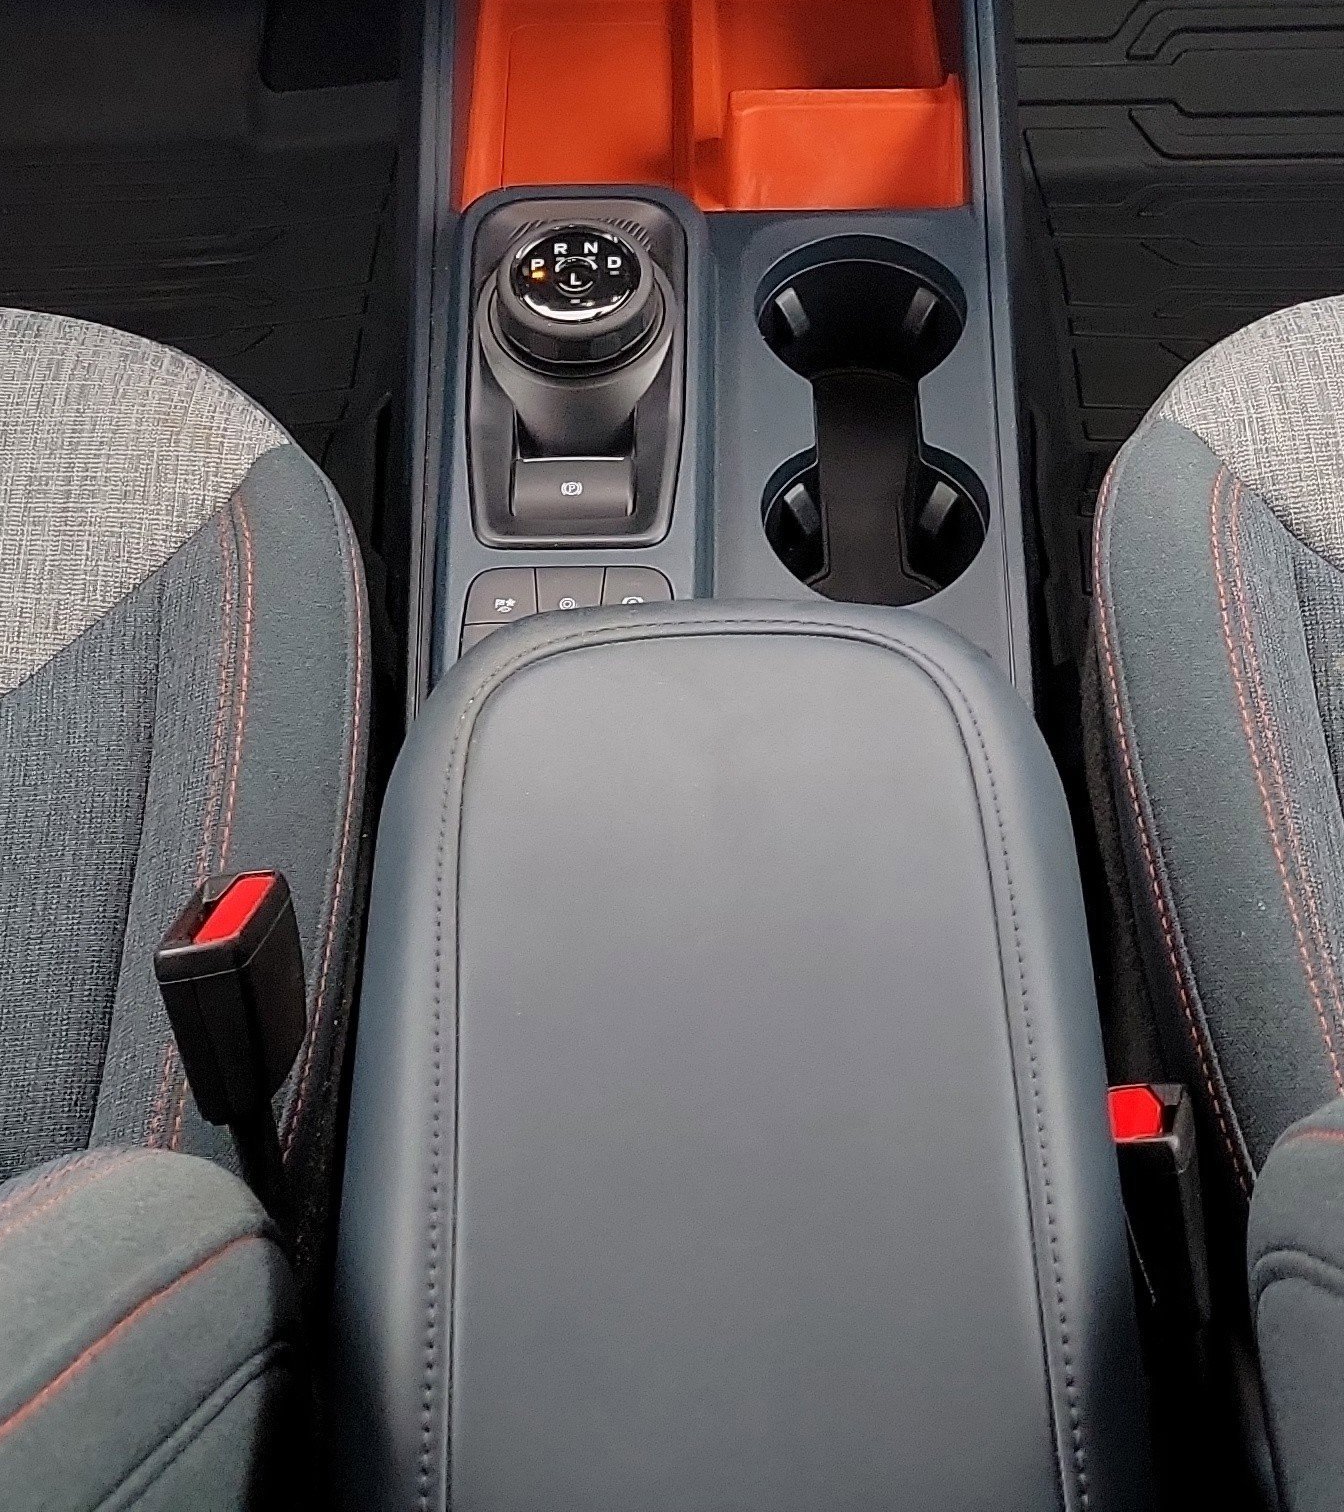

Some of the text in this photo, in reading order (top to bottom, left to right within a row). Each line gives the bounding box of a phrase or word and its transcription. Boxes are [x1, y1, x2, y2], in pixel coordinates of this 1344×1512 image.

[554, 243, 568, 255] R
[583, 241, 598, 254] N
[530, 258, 545, 271] P
[607, 257, 622, 269] D
[570, 273, 582, 286] L
